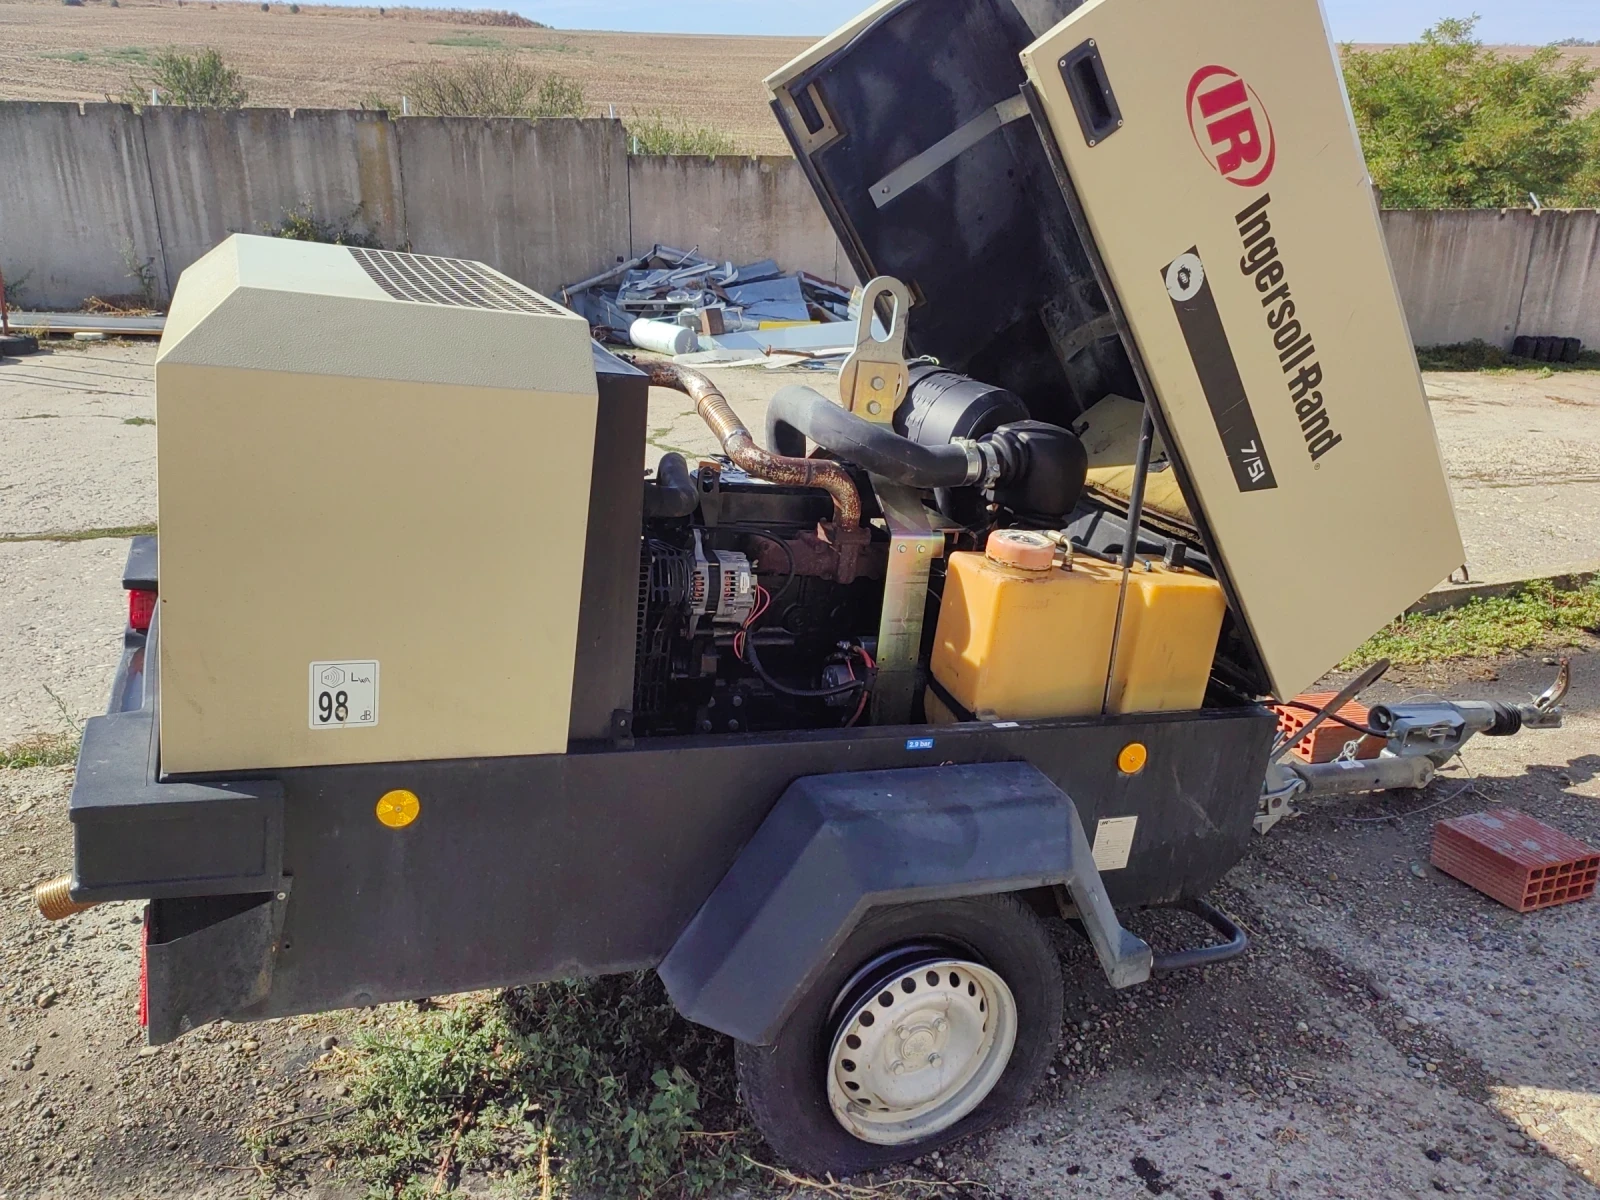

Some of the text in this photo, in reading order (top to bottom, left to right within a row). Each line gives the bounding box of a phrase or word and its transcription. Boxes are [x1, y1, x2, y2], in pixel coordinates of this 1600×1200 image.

[1197, 78, 1262, 175] IR
[1240, 439, 1266, 483] 7/51
[318, 690, 371, 723] 98 dB
